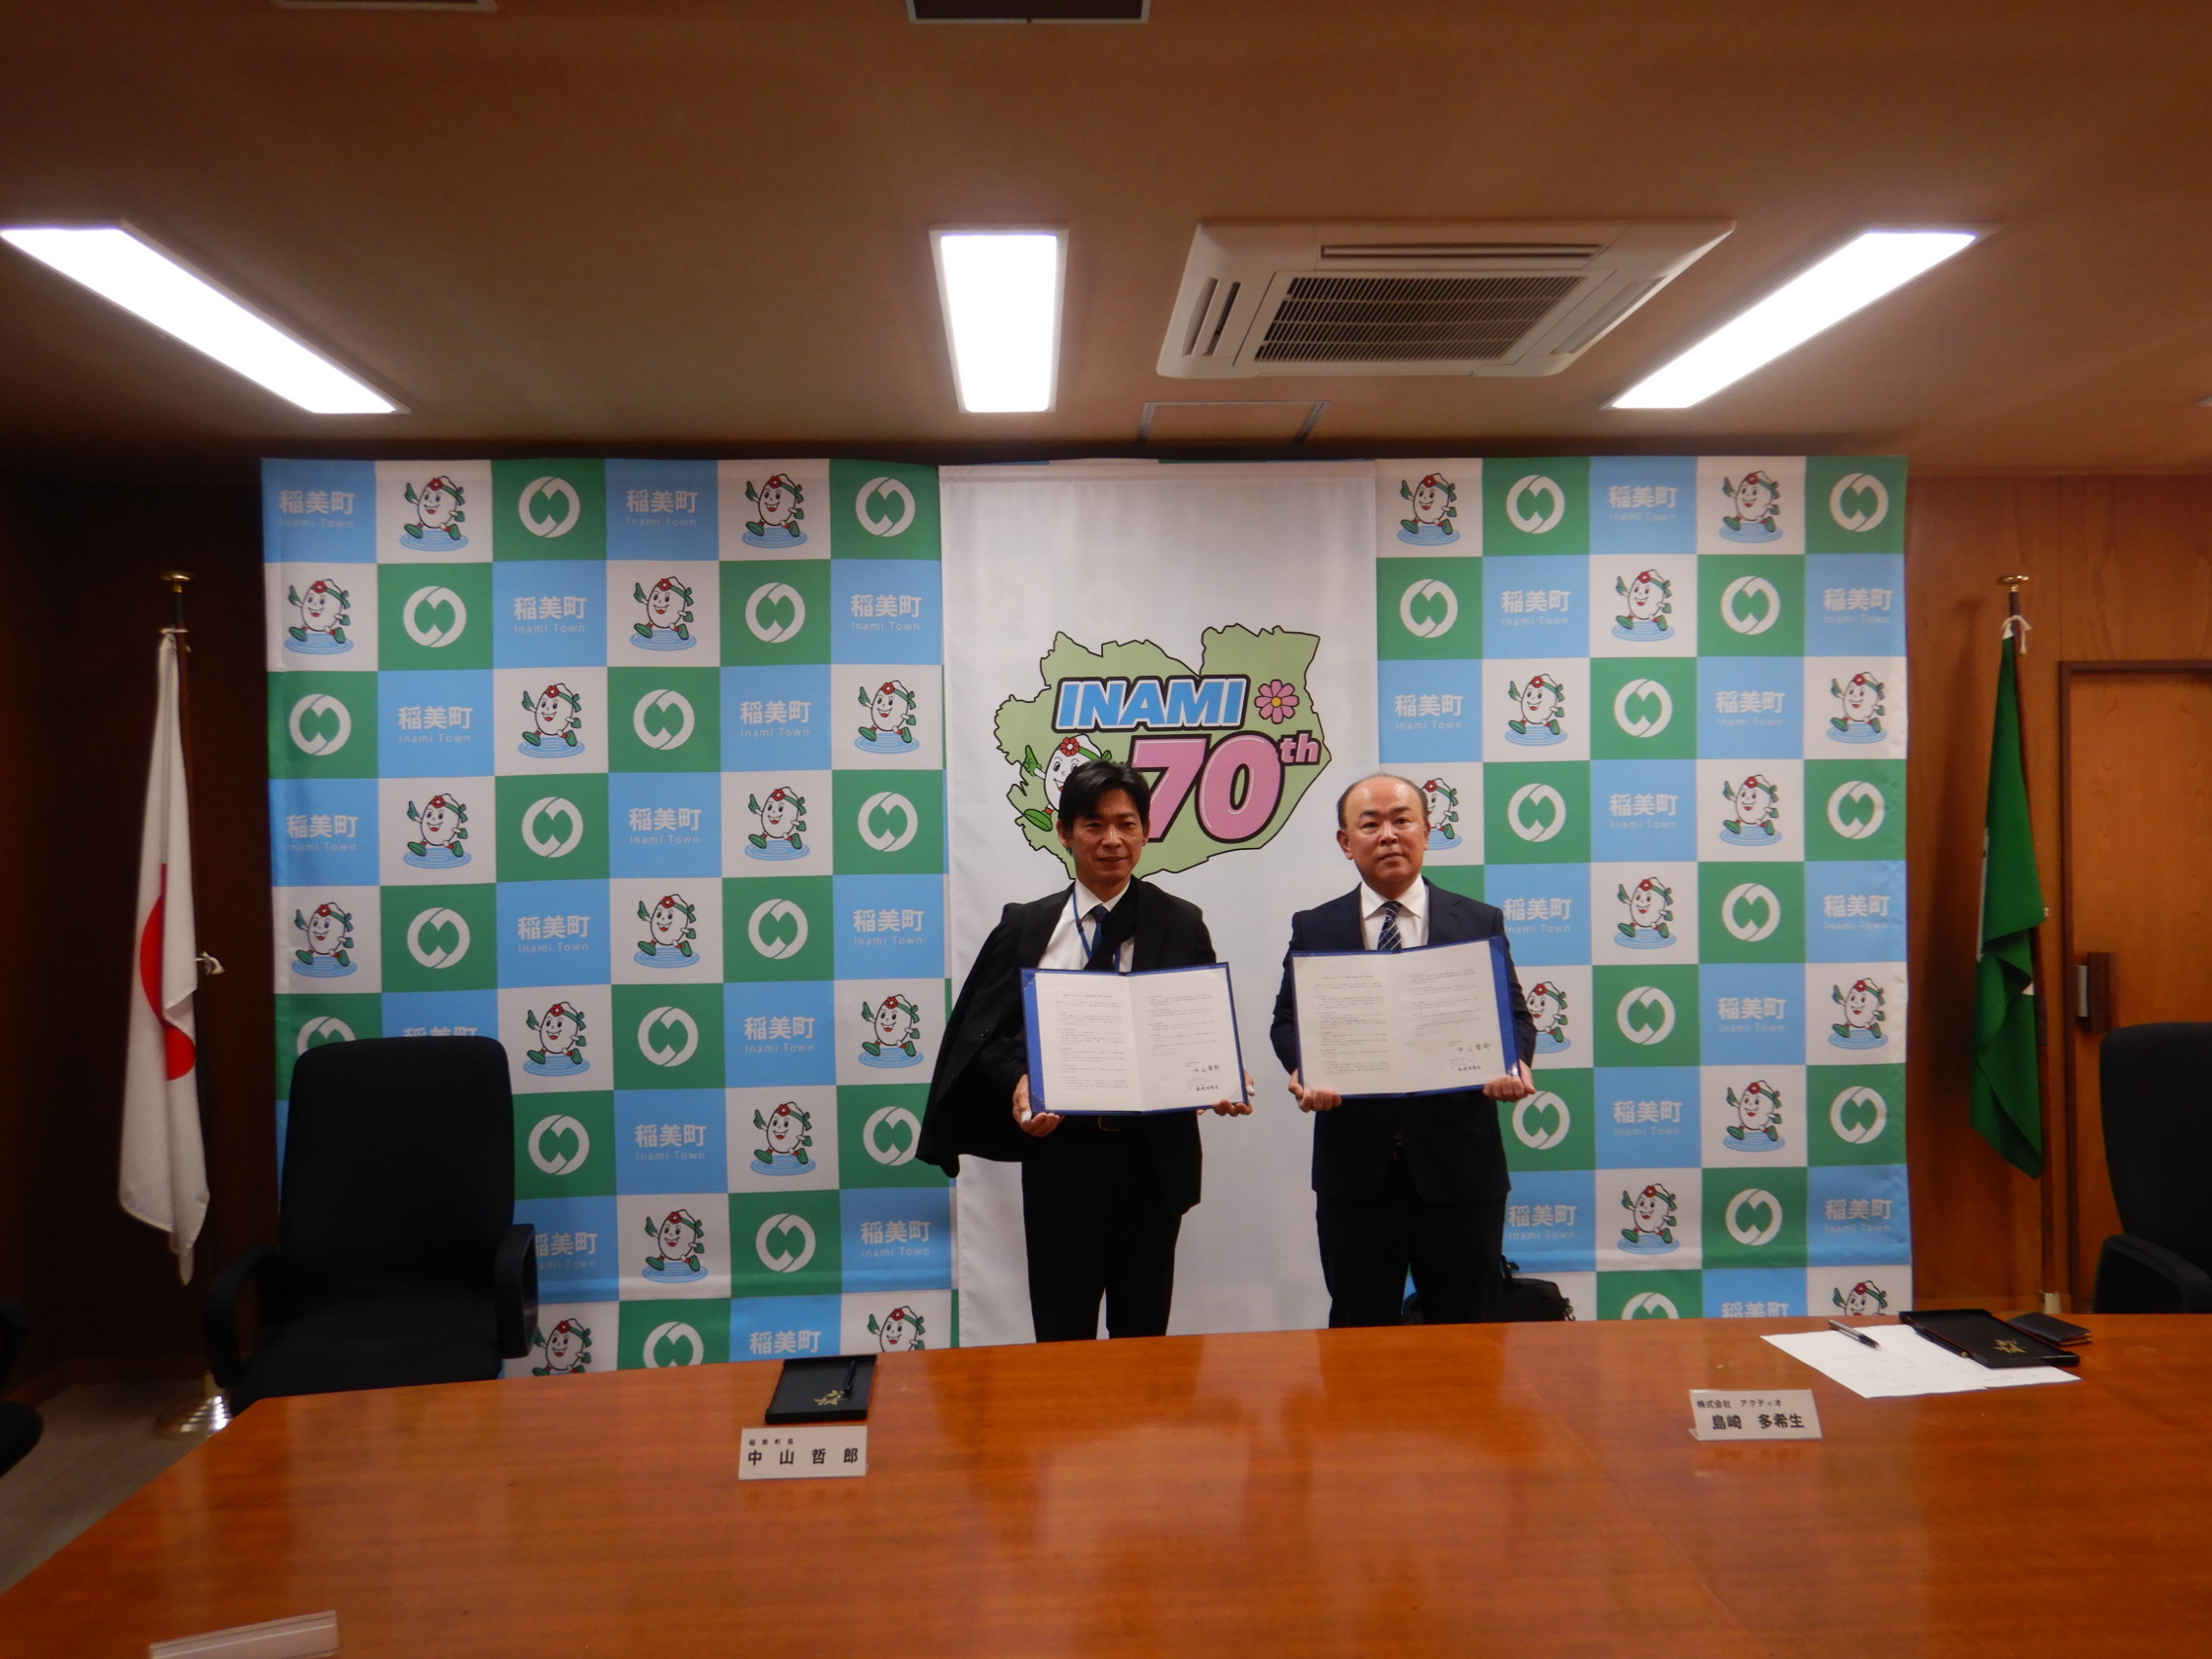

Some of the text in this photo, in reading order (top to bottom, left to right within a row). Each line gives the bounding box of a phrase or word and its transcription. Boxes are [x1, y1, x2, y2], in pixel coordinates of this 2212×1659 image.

[278, 490, 356, 515] 稲美町
[626, 489, 699, 514] 稲美町
[1607, 485, 1678, 509] 稲美町
[278, 517, 354, 528] Inami Town
[626, 516, 697, 527] Inami Town
[1607, 511, 1677, 522] Inami Town
[512, 596, 588, 621] 稲美町
[850, 594, 923, 618] 稲美町
[1500, 589, 1571, 613] 稲美町
[1823, 587, 1894, 611] 稲美町
[512, 622, 586, 634] Inami Town
[850, 619, 921, 631] Inami Town
[1500, 615, 1569, 626] Inami Town
[1823, 613, 1892, 624] Inami Town
[739, 700, 812, 725] 稲美町
[1054, 678, 1248, 731] INAMI
[1393, 693, 1464, 718] 稲美町
[1714, 690, 1786, 714] 稲美町
[397, 705, 474, 730] 稲美町
[1393, 719, 1462, 730] Inami Town
[1714, 716, 1784, 726] Inami Town
[397, 731, 472, 743] Inami Town
[739, 726, 810, 738] Inami Town
[1608, 793, 1679, 817] 稲美町
[285, 814, 359, 838] 稲美町
[628, 807, 703, 831] 稲美町
[1608, 819, 1677, 830] Inami Town
[285, 840, 357, 851] Inami Town
[628, 832, 701, 844] Inami Town
[1502, 897, 1573, 921] 稲美町
[1823, 894, 1891, 918] 稲美町
[517, 914, 591, 940] 稲美町
[852, 908, 925, 933] 稲美町
[1823, 920, 1889, 931] Inami Town
[517, 941, 589, 953] Inami Town
[852, 934, 923, 945] Inami Town
[1716, 996, 1788, 1020] 稲美町
[743, 1015, 816, 1041] 稲美町
[1716, 1022, 1786, 1033] Inami Town
[743, 1042, 814, 1053] Inami Town
[1612, 1099, 1683, 1124] 稲美町
[634, 1124, 708, 1148] 稲美町
[1612, 1125, 1681, 1136] Inami Town
[634, 1149, 706, 1161] Inami Town
[1507, 1203, 1577, 1228] 稲美町
[1824, 1198, 1894, 1221] 稲美町
[860, 1220, 932, 1245] 稲美町
[1507, 1230, 1575, 1240] Inami Town
[1824, 1223, 1892, 1234] Inami Town
[860, 1246, 930, 1258] Inami Town
[537, 1260, 560, 1271] ami
[748, 1329, 823, 1355] 稲美町
[1757, 1413, 1805, 1429] 多希生
